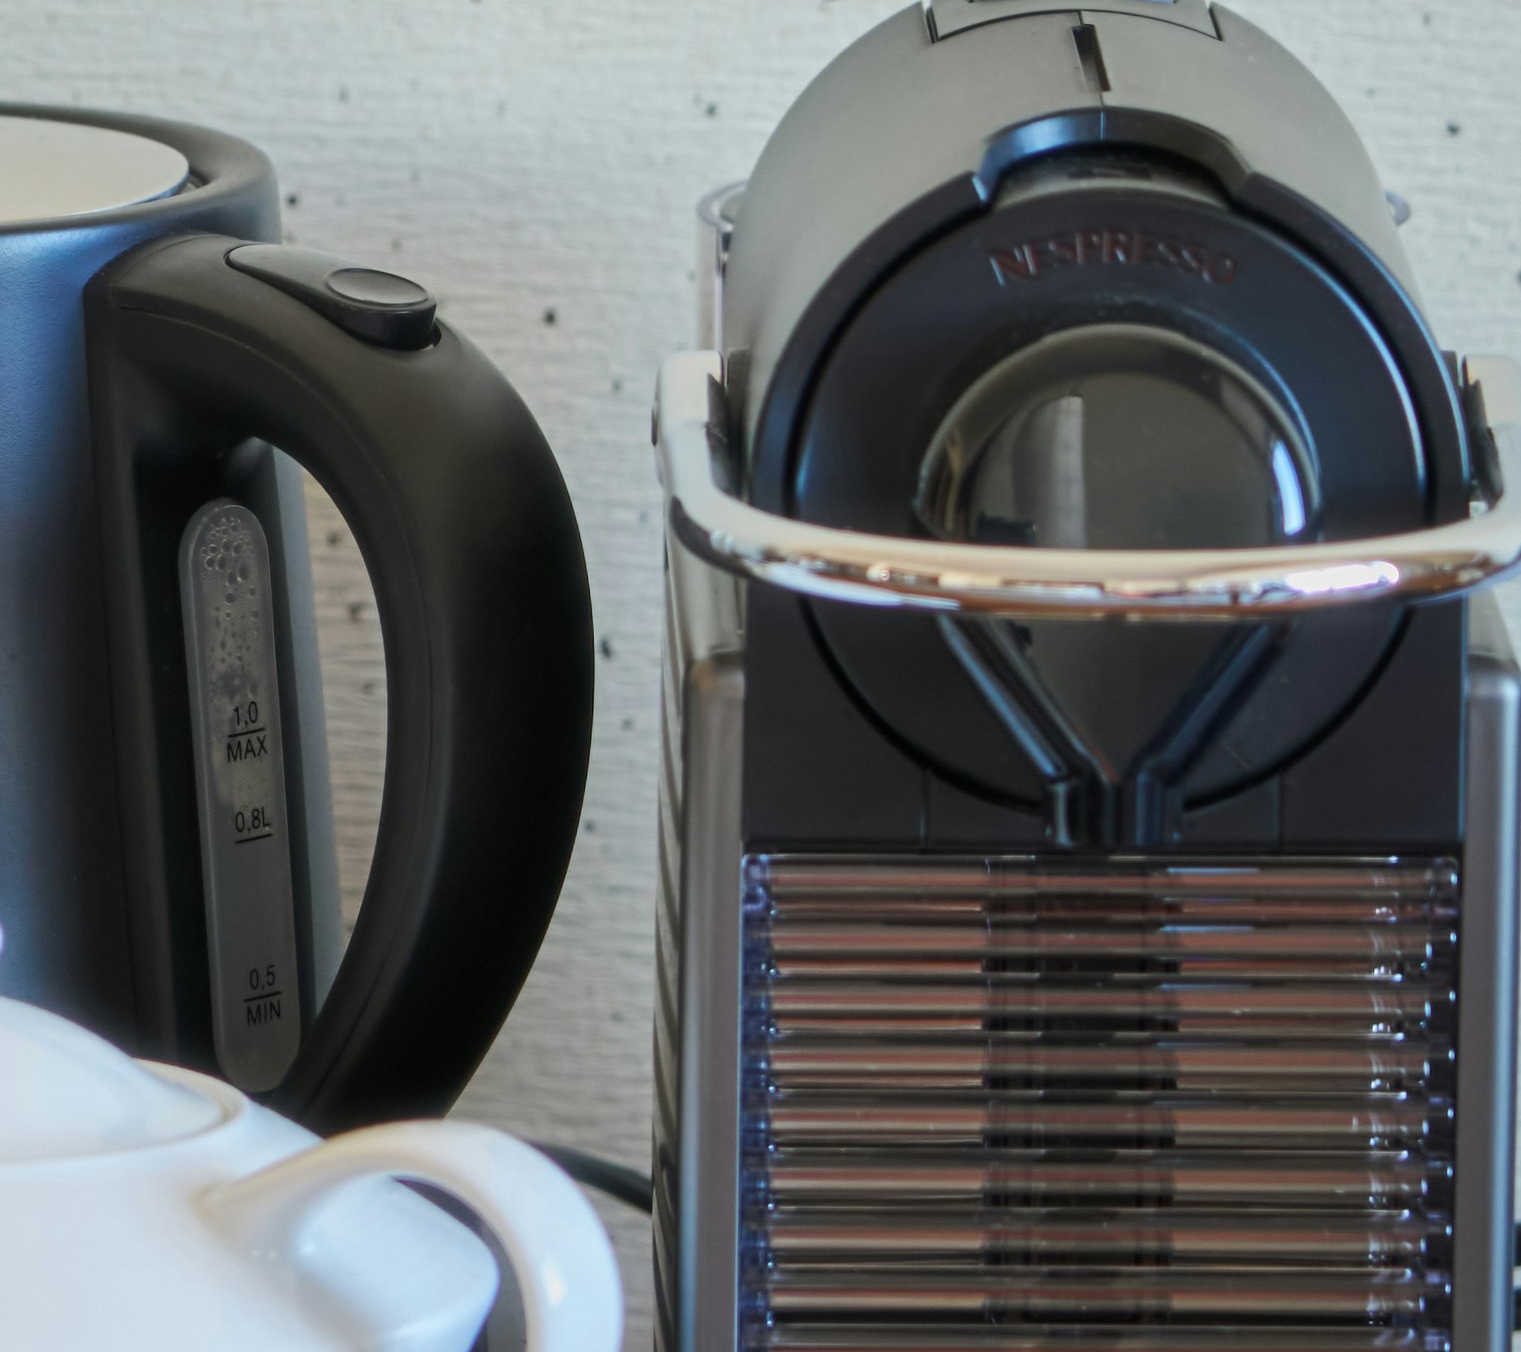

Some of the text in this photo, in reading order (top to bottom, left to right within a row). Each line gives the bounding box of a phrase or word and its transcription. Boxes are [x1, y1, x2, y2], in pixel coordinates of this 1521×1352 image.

[988, 229, 1238, 289] NESPRESSO
[226, 734, 268, 763] MAX
[247, 999, 281, 1026] MIN
